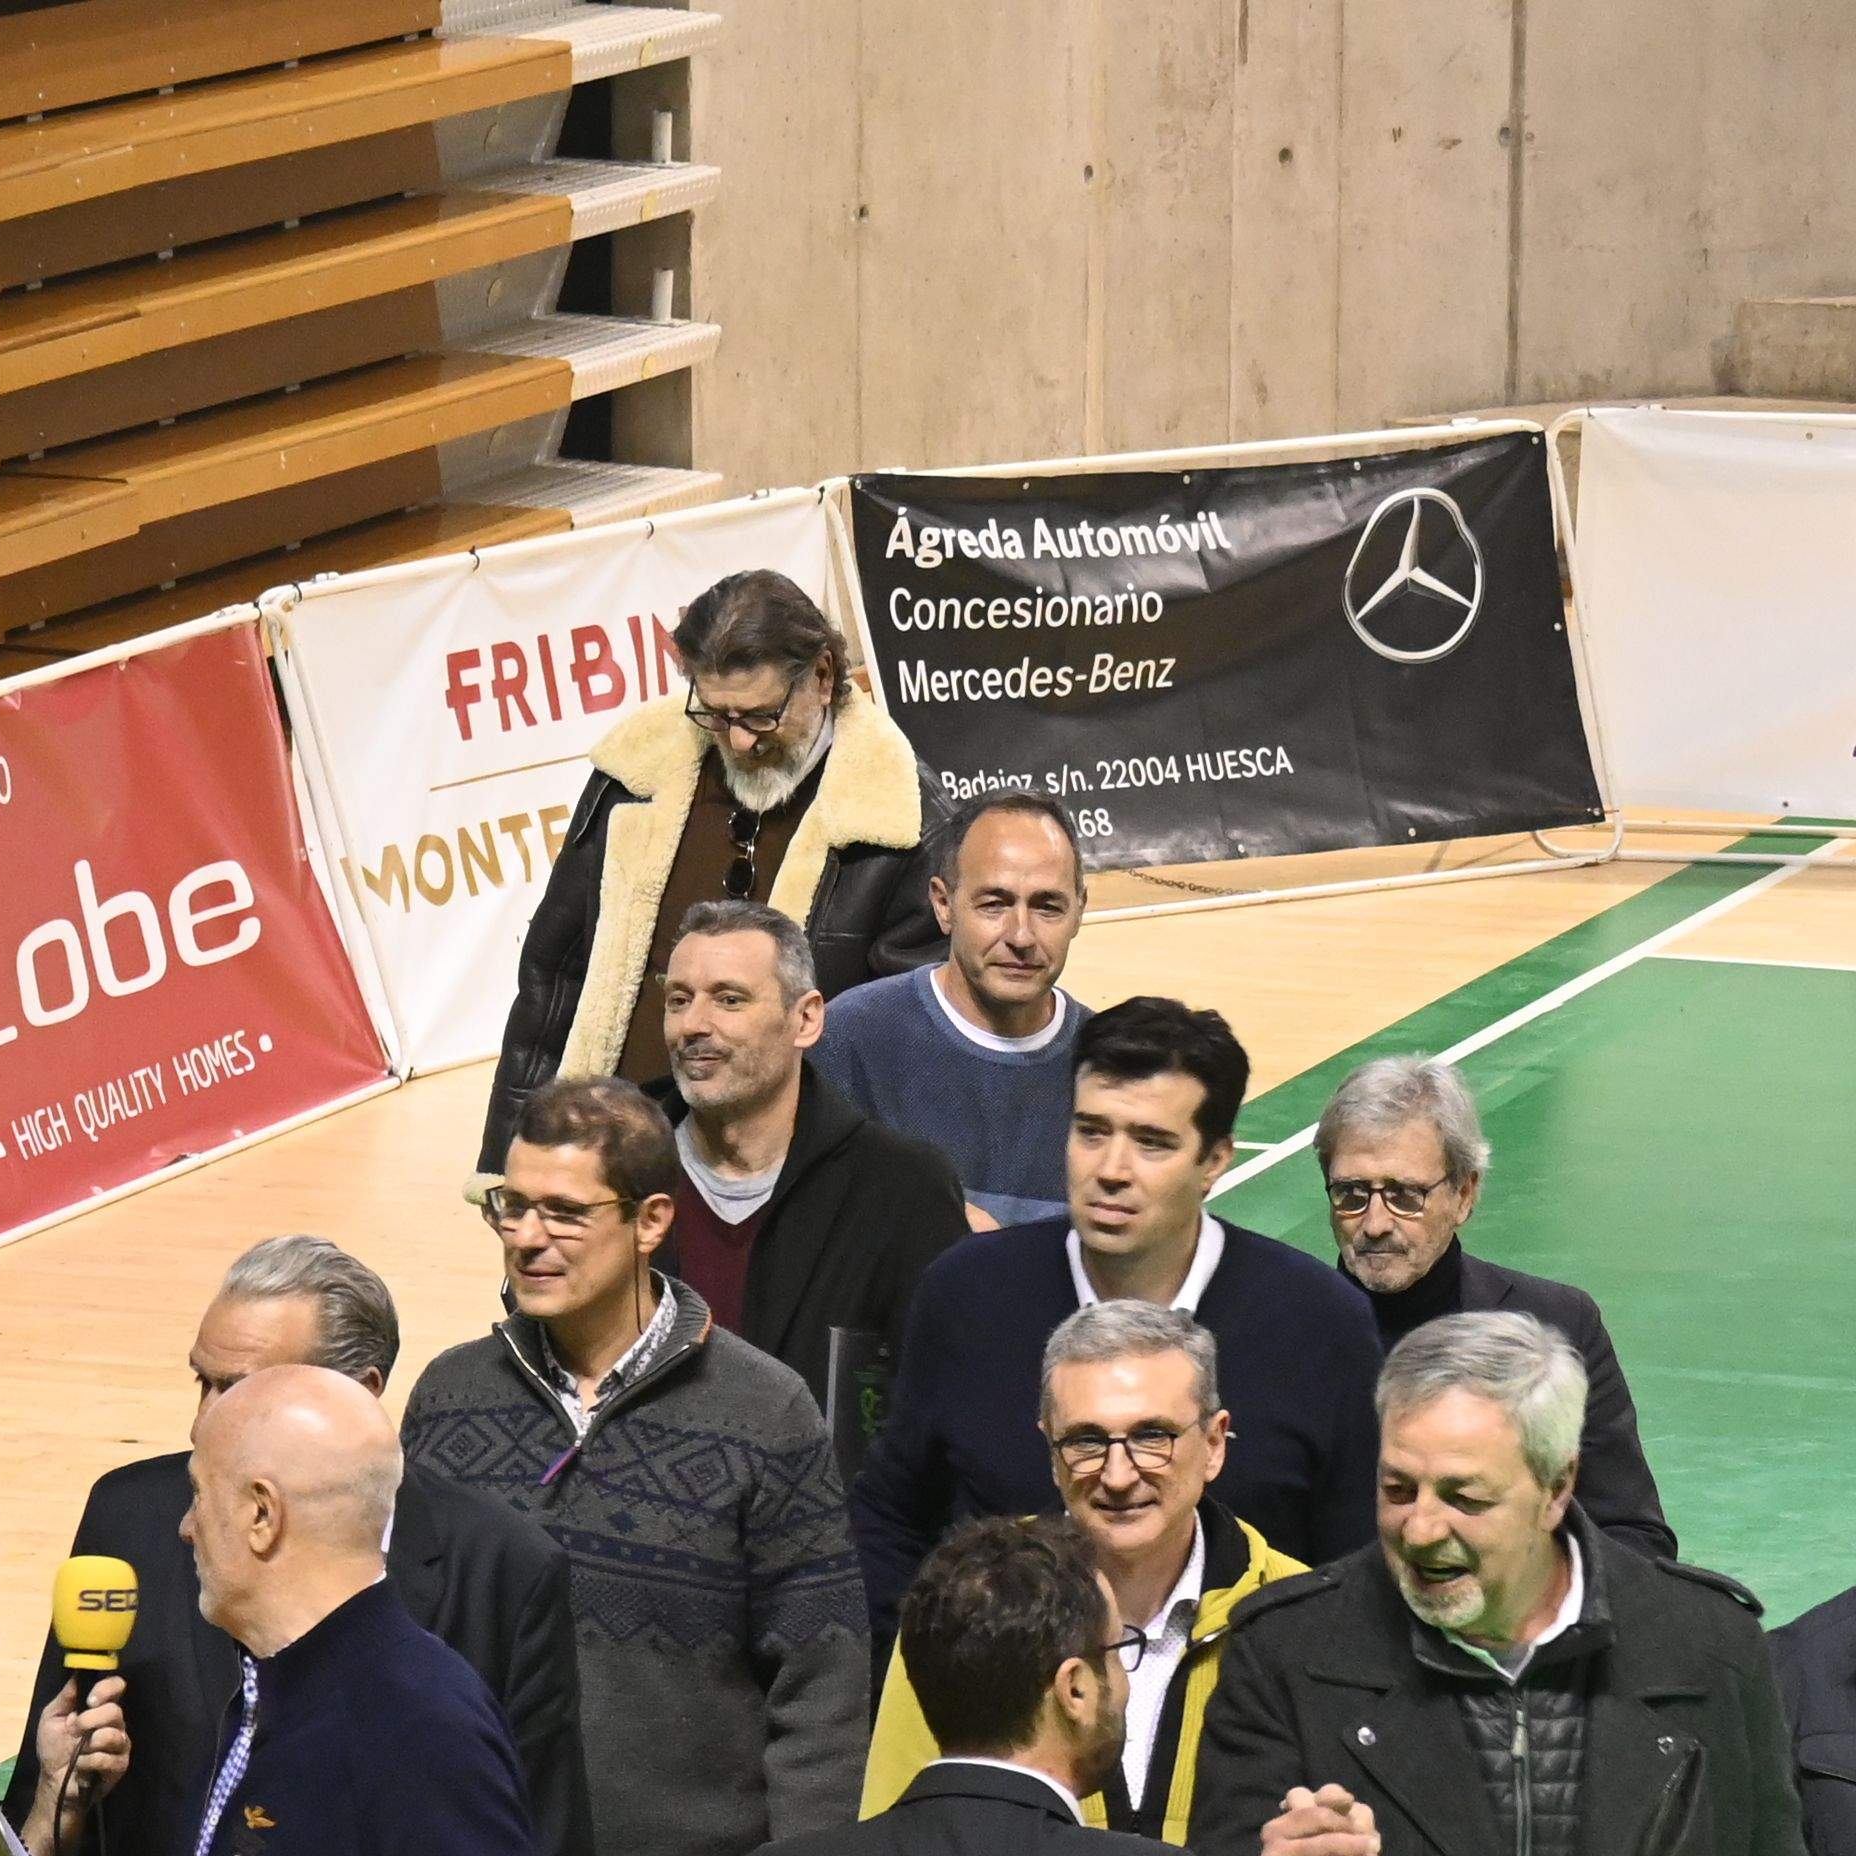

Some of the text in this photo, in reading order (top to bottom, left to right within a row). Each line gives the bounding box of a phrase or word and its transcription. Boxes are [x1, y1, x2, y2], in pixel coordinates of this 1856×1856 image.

[885, 507, 1233, 569] Ágreda Automóvil
[889, 583, 1164, 632] Concesionario
[898, 653, 1176, 704] Mercedes-Benz
[1045, 764, 1094, 797] s/n.
[1096, 755, 1181, 790] 22004
[1185, 746, 1295, 783] HUESCA
[11, 1030, 256, 1160] HIGH QUALITY HOMES
